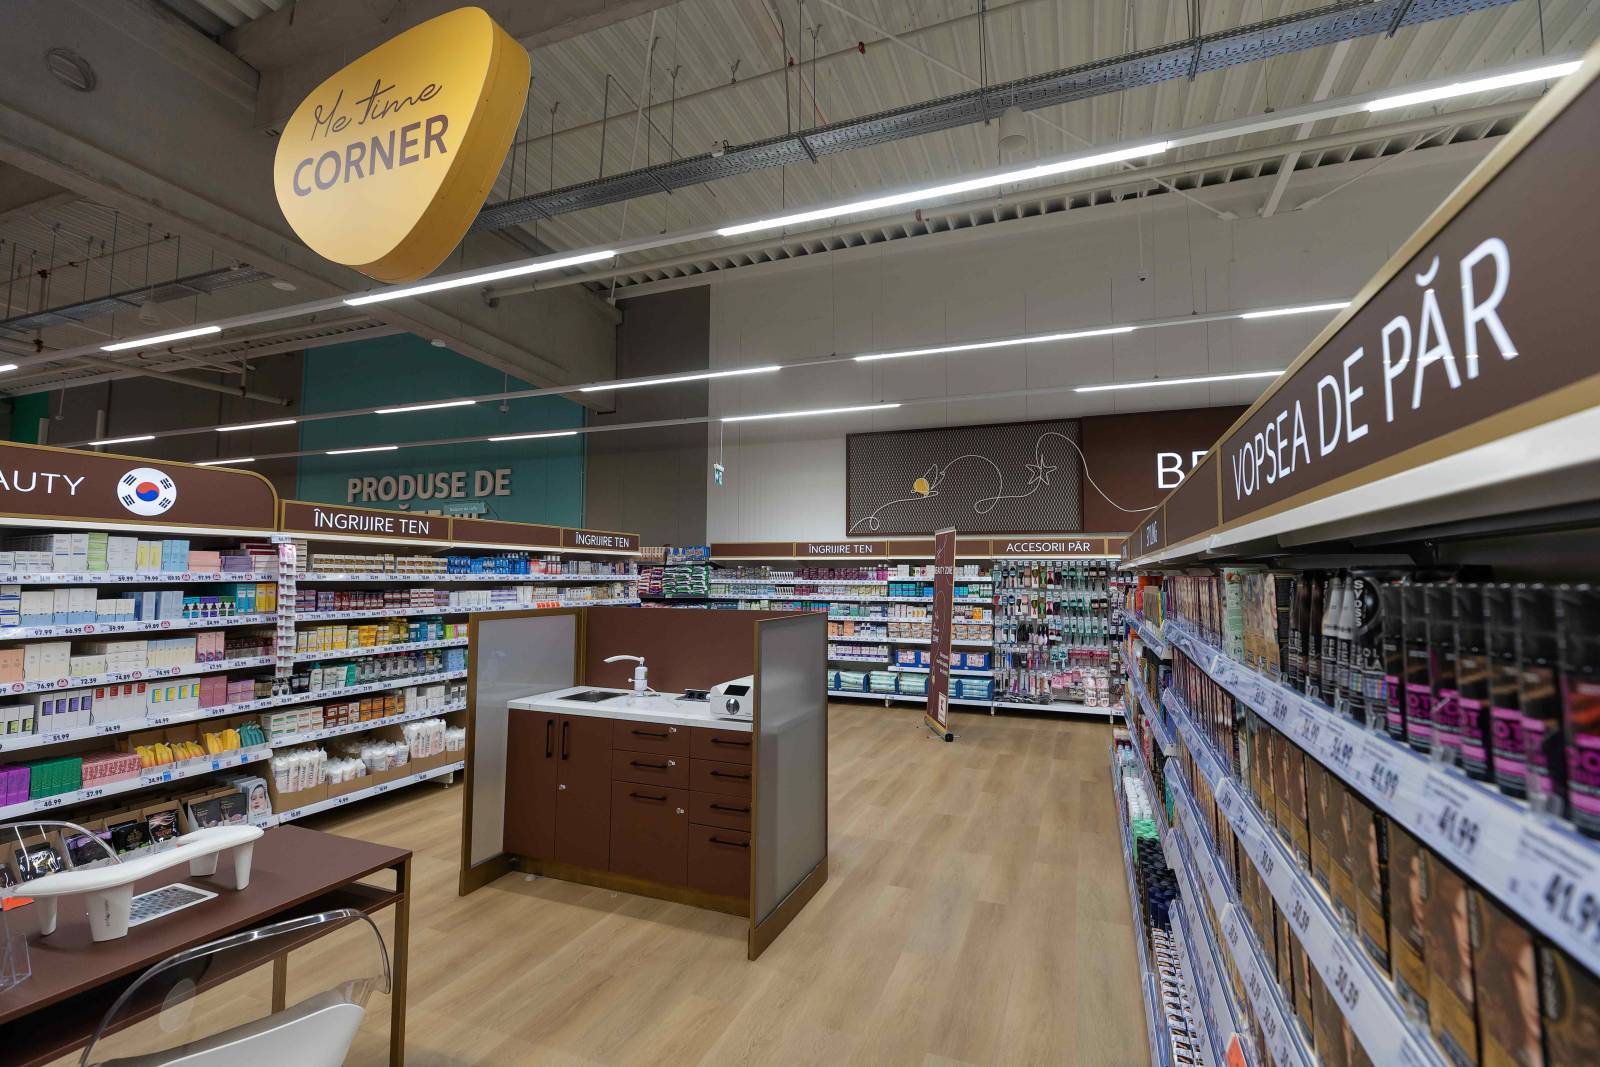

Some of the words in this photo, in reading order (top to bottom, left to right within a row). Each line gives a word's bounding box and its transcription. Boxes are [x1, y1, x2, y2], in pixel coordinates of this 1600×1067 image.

[310, 89, 352, 141] Me
[355, 78, 443, 125] time
[293, 114, 449, 197] CORNER
[1232, 400, 1311, 500] VOPSEA
[1317, 346, 1369, 456] DE
[1381, 237, 1519, 423] PĂR
[347, 471, 467, 503] PRODUSE
[474, 468, 512, 498] DE
[314, 508, 394, 533] ÎNGRIJIRE
[399, 518, 430, 535] TEN
[575, 531, 613, 547] ÎNGRIJIRE
[615, 536, 630, 548] TEN
[808, 543, 851, 555] ÎNGRIJIRE
[854, 544, 873, 554] TEN
[1006, 541, 1066, 553] ACCESORII
[1067, 540, 1091, 553] PĂR
[37, 682, 55, 690] 76.99
[43, 799, 62, 807] 40.99
[86, 789, 103, 798] 37.99
[1335, 964, 1360, 1010] 30.39
